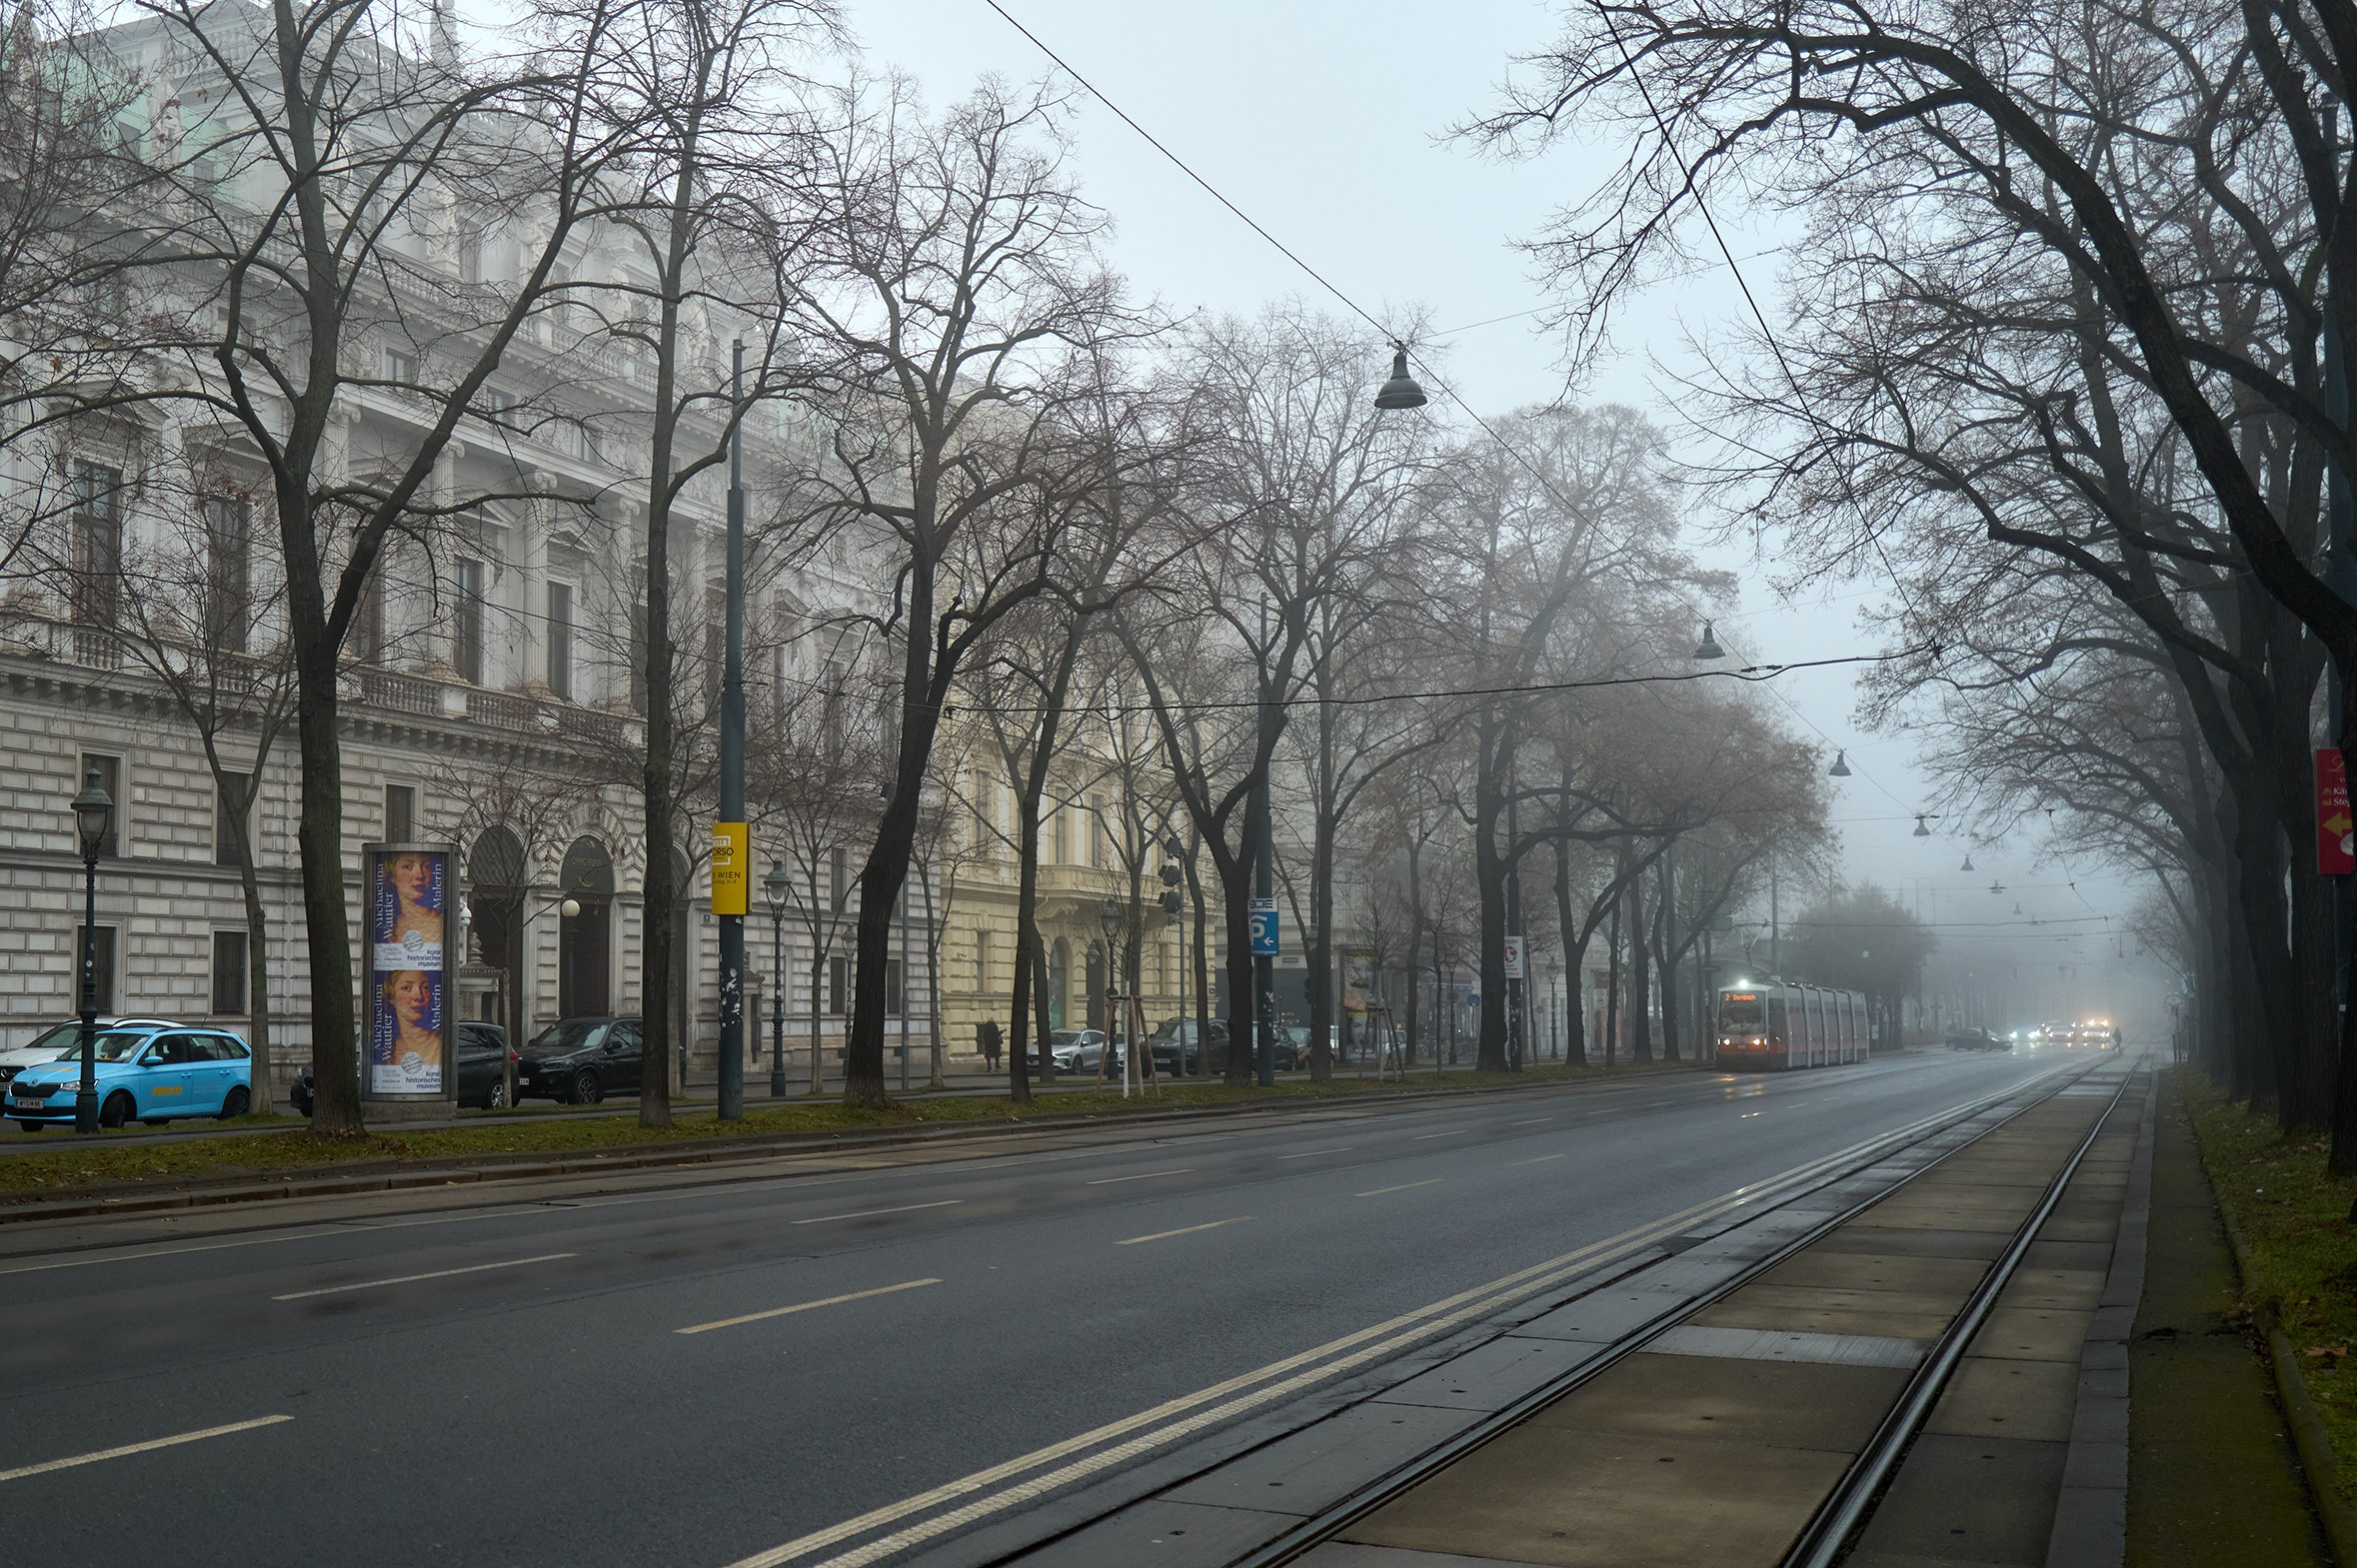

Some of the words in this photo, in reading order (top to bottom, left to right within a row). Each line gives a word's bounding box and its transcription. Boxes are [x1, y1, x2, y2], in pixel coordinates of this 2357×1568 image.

[432, 863, 442, 909] Malerin
[383, 892, 394, 939] Wautier
[374, 983, 383, 1050] Michaelina
[431, 984, 441, 1031] Malerin
[382, 1014, 393, 1061] Wautier
